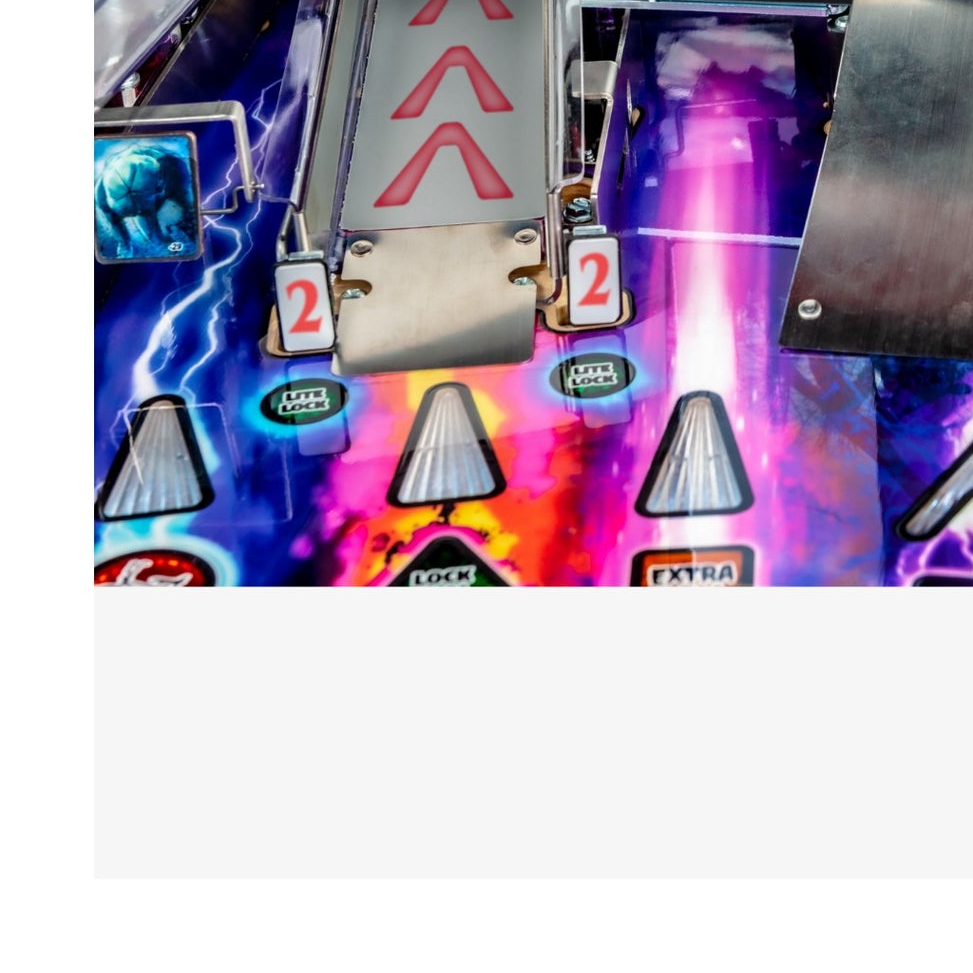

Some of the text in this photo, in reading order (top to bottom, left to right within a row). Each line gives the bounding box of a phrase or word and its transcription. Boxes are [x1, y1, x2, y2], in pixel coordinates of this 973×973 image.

[579, 252, 611, 306] 2
[285, 279, 323, 334] 2
[572, 364, 612, 375] LITE
[570, 375, 616, 387] LOCK
[284, 389, 325, 401] LITE
[280, 400, 327, 414] LOCK
[415, 570, 470, 585] LOCK
[652, 565, 733, 584] EXTRA
